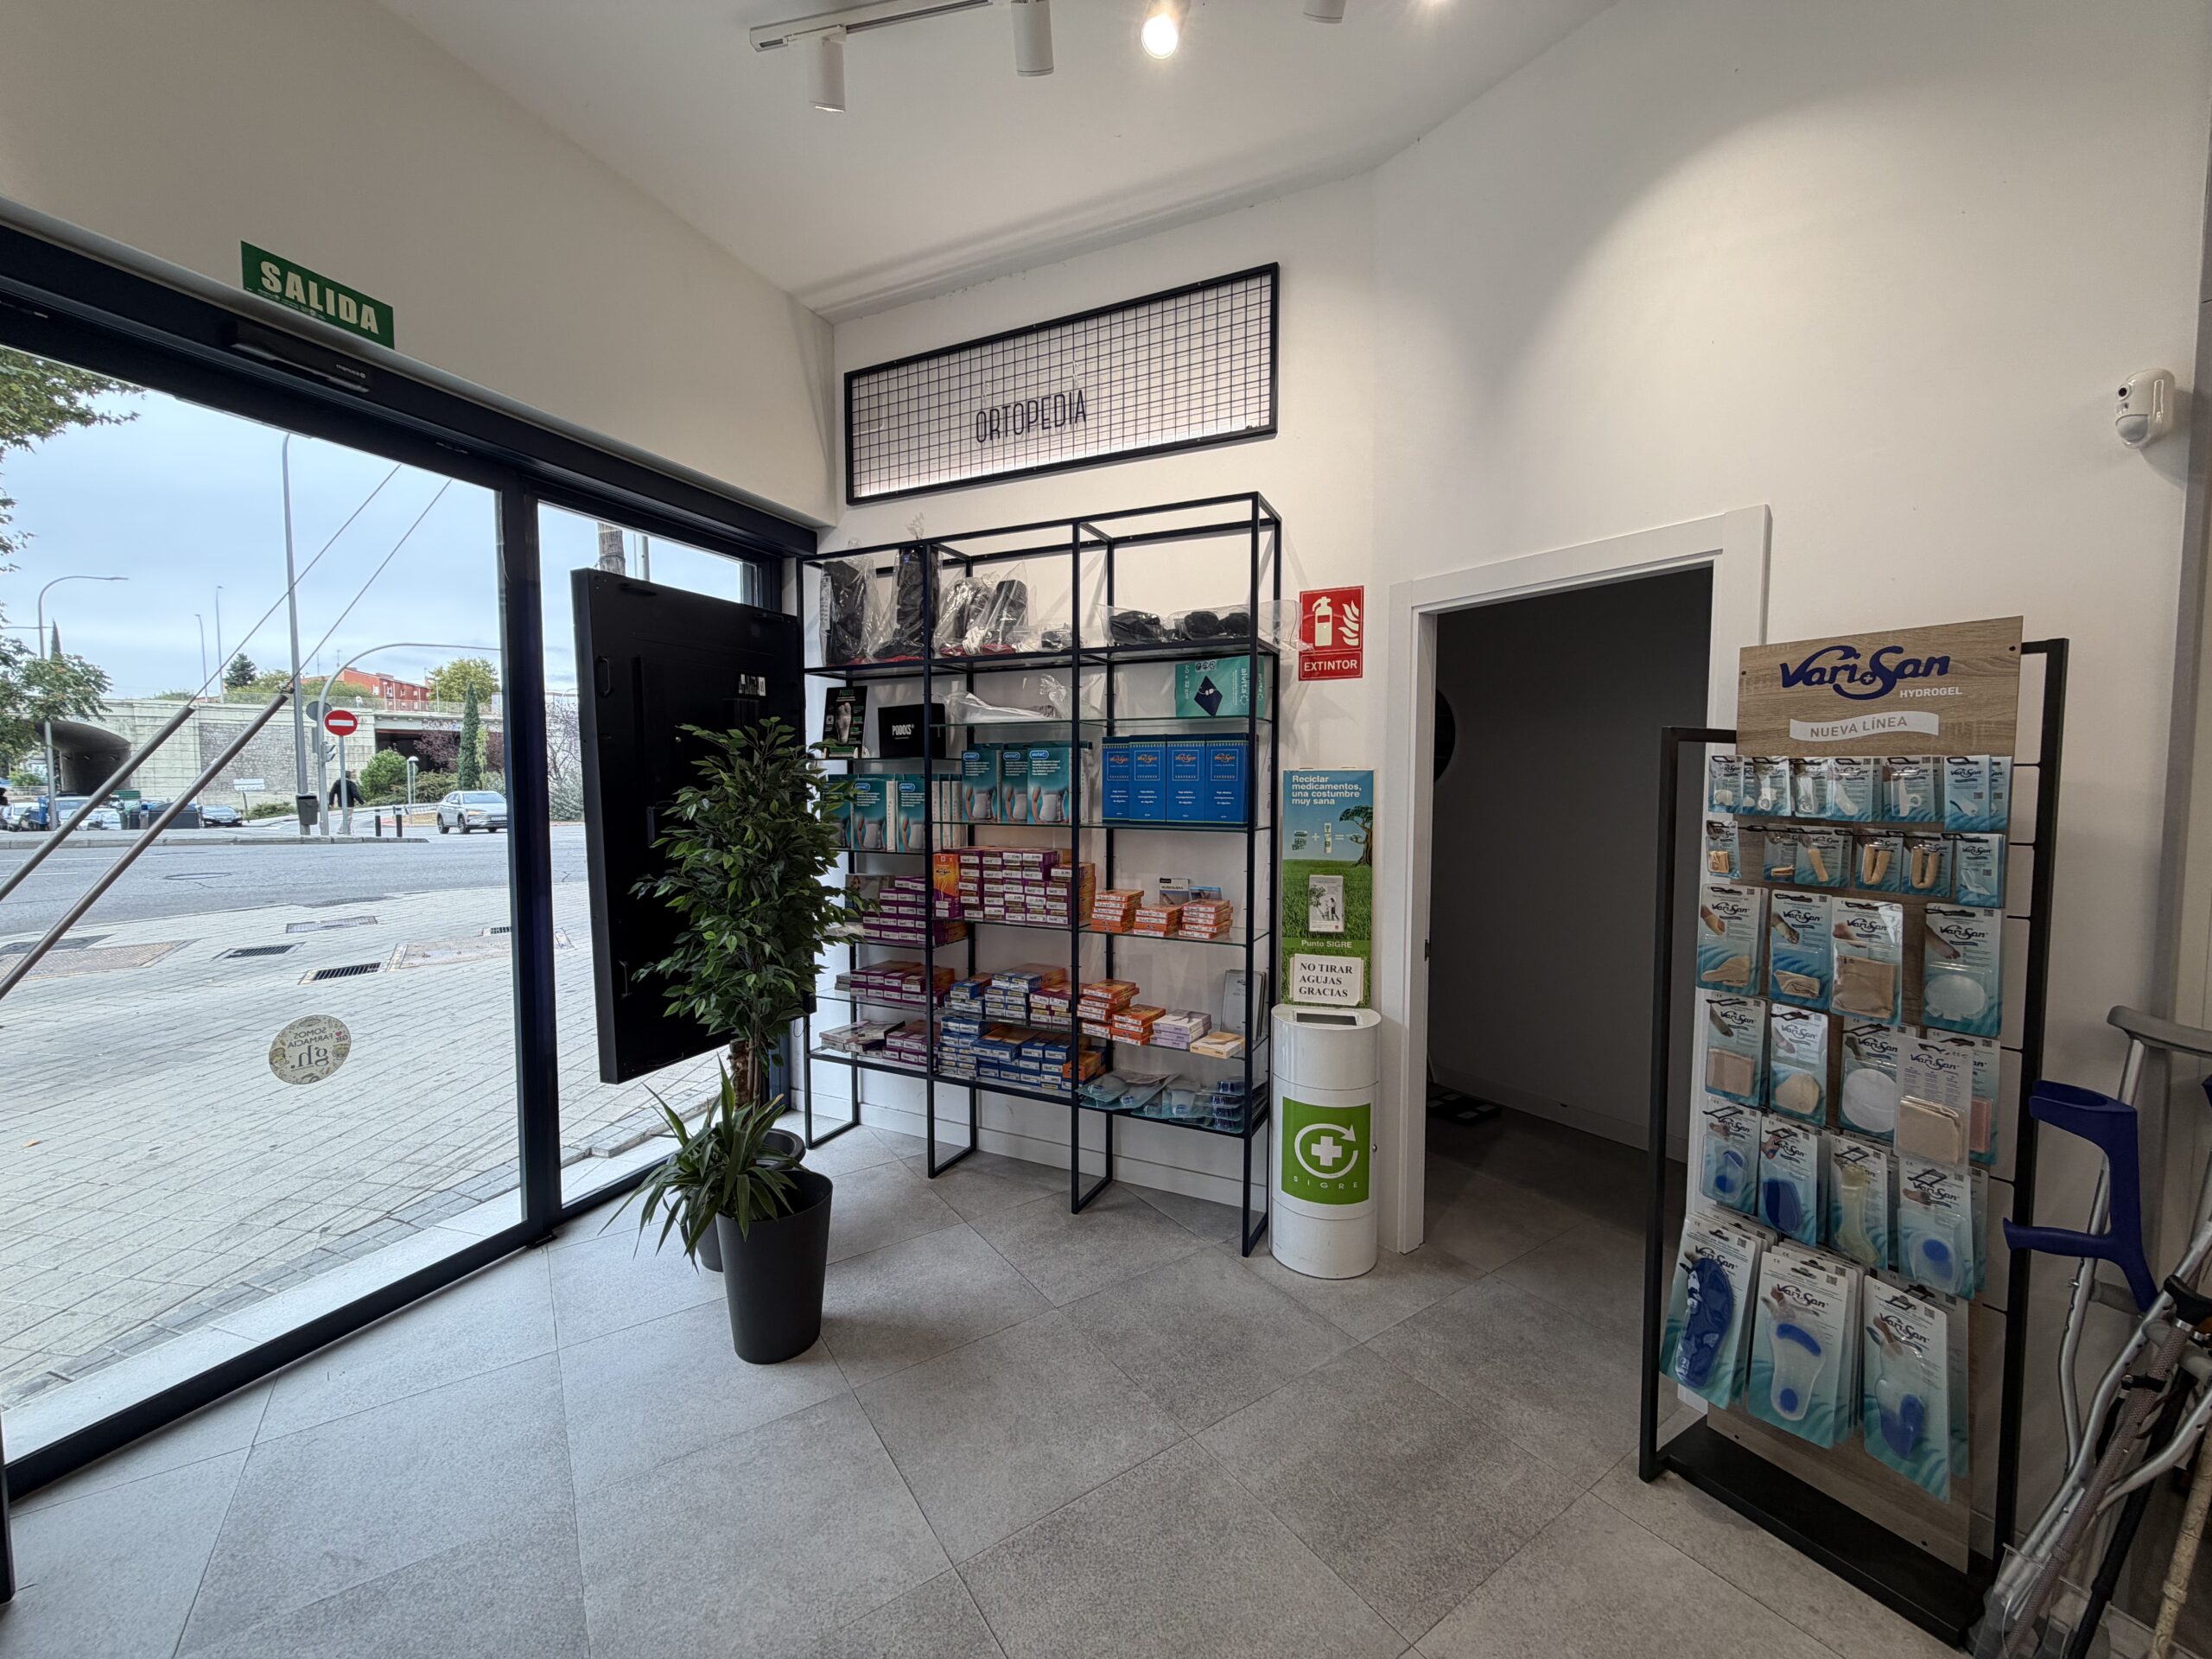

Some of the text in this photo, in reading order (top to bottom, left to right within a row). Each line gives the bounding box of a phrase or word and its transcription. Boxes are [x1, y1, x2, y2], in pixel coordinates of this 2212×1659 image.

[260, 261, 379, 334] SALIDA
[976, 389, 1087, 443] ORTOPEDIA
[1304, 659, 1357, 671] EXTINTOR
[1779, 645, 1951, 701] VariSan
[1899, 686, 1963, 698] HYDROGEL
[1810, 715, 1908, 738] NUEVA LÍNEA
[1300, 963, 1353, 974] NO TIRAR
[1300, 975, 1342, 985] AGUJAS
[1299, 986, 1348, 997] GRACIAS
[1293, 1175, 1359, 1190] SIGRE
